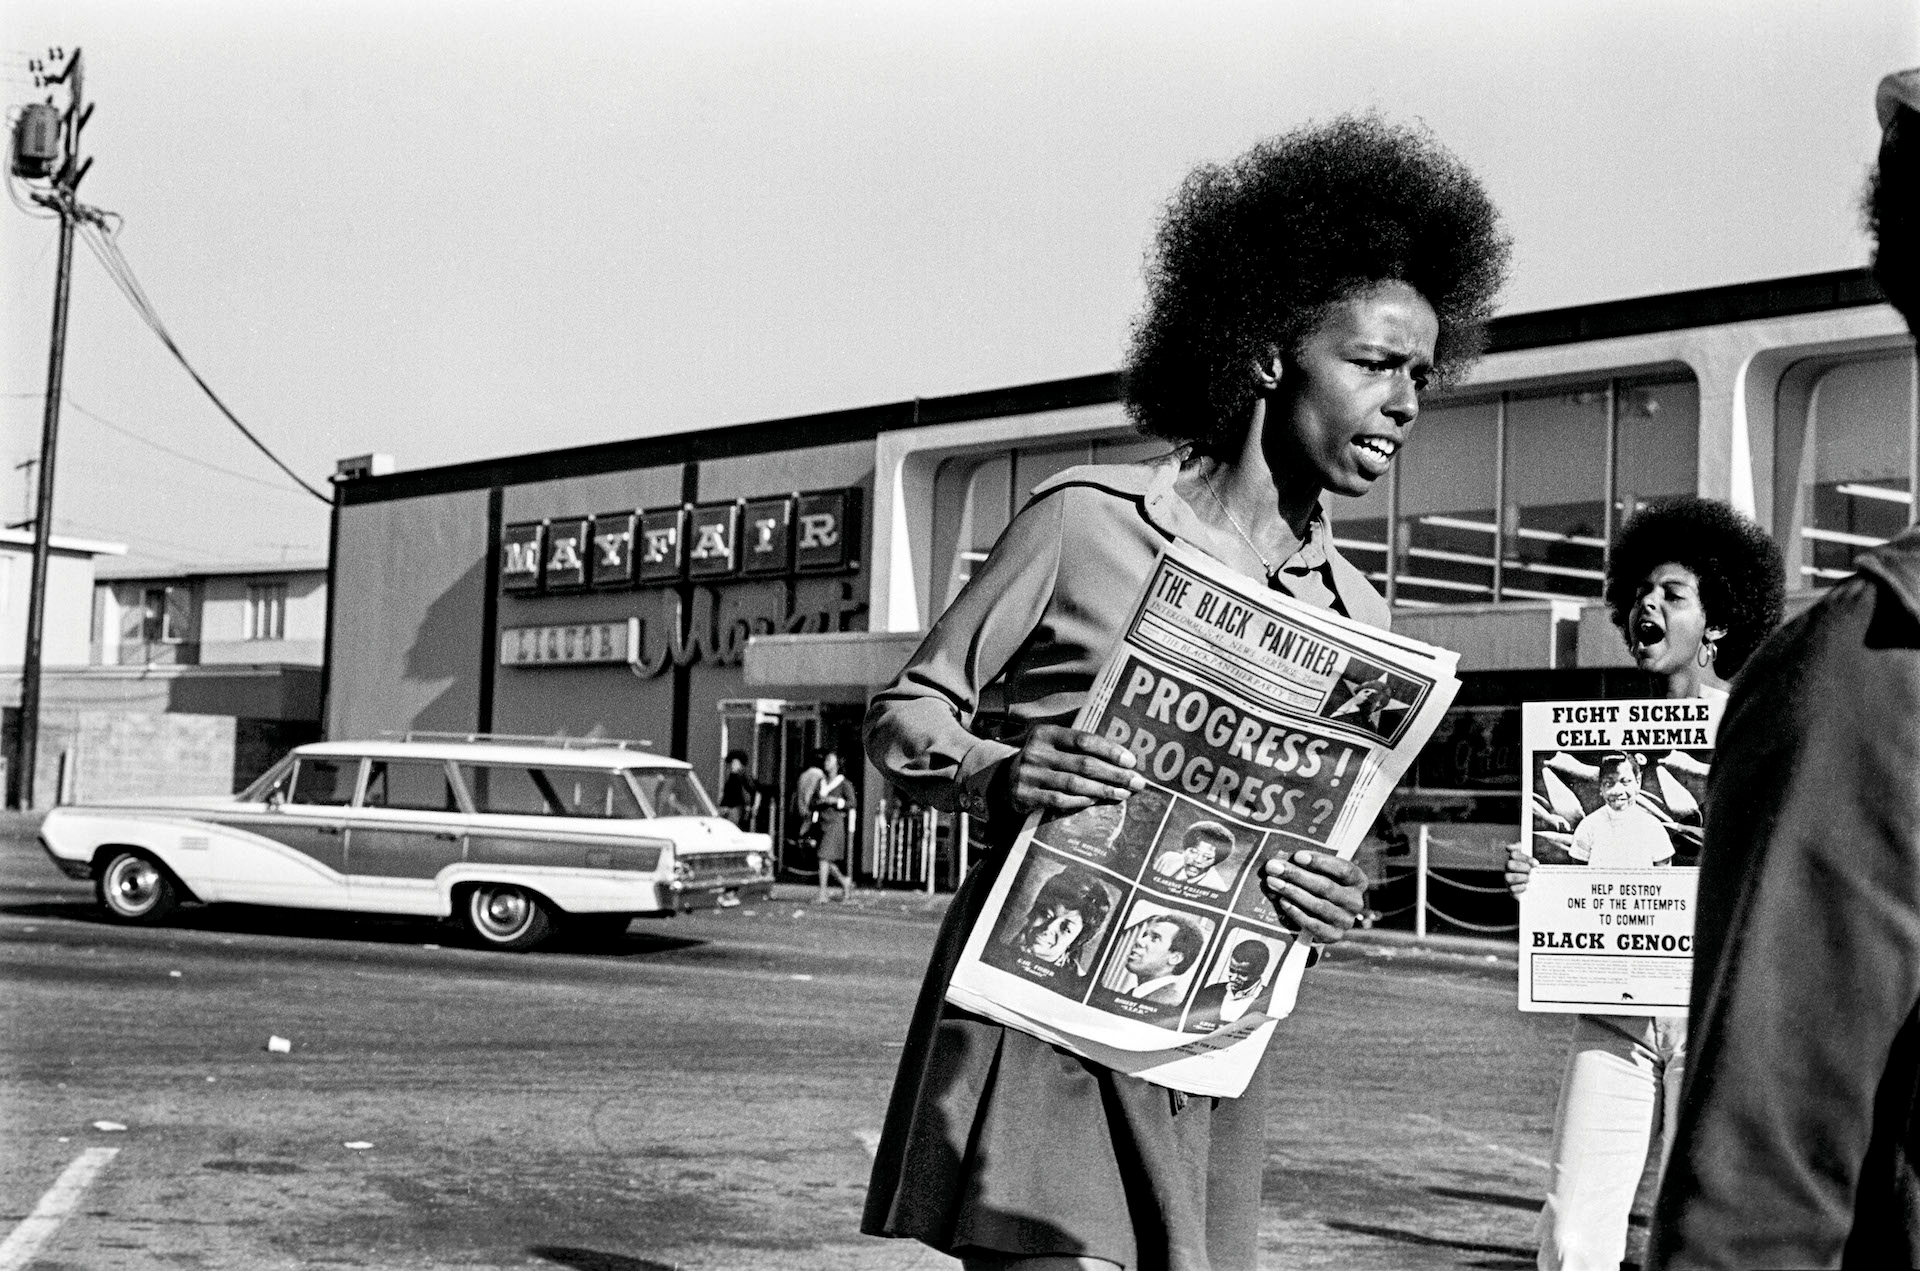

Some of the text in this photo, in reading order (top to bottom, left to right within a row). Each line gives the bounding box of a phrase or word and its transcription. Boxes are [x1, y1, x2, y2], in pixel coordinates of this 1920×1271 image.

[504, 512, 838, 573] MAYFAIR
[1156, 570, 1339, 677] THE BLACK PANTHER
[1161, 634, 1179, 649] THE
[1180, 641, 1208, 663] BLACK
[1121, 665, 1330, 778] PROGRESS
[1552, 705, 1709, 723] FIGHT SICKLE
[1556, 728, 1708, 746] CELL ANEMIA
[1591, 884, 1662, 896] HELP DESTROY
[1567, 897, 1686, 911] ONE OF THE ATTEMPTS
[1599, 914, 1655, 926] TO COMMIT
[1532, 931, 1694, 951] BLACK GENOC
